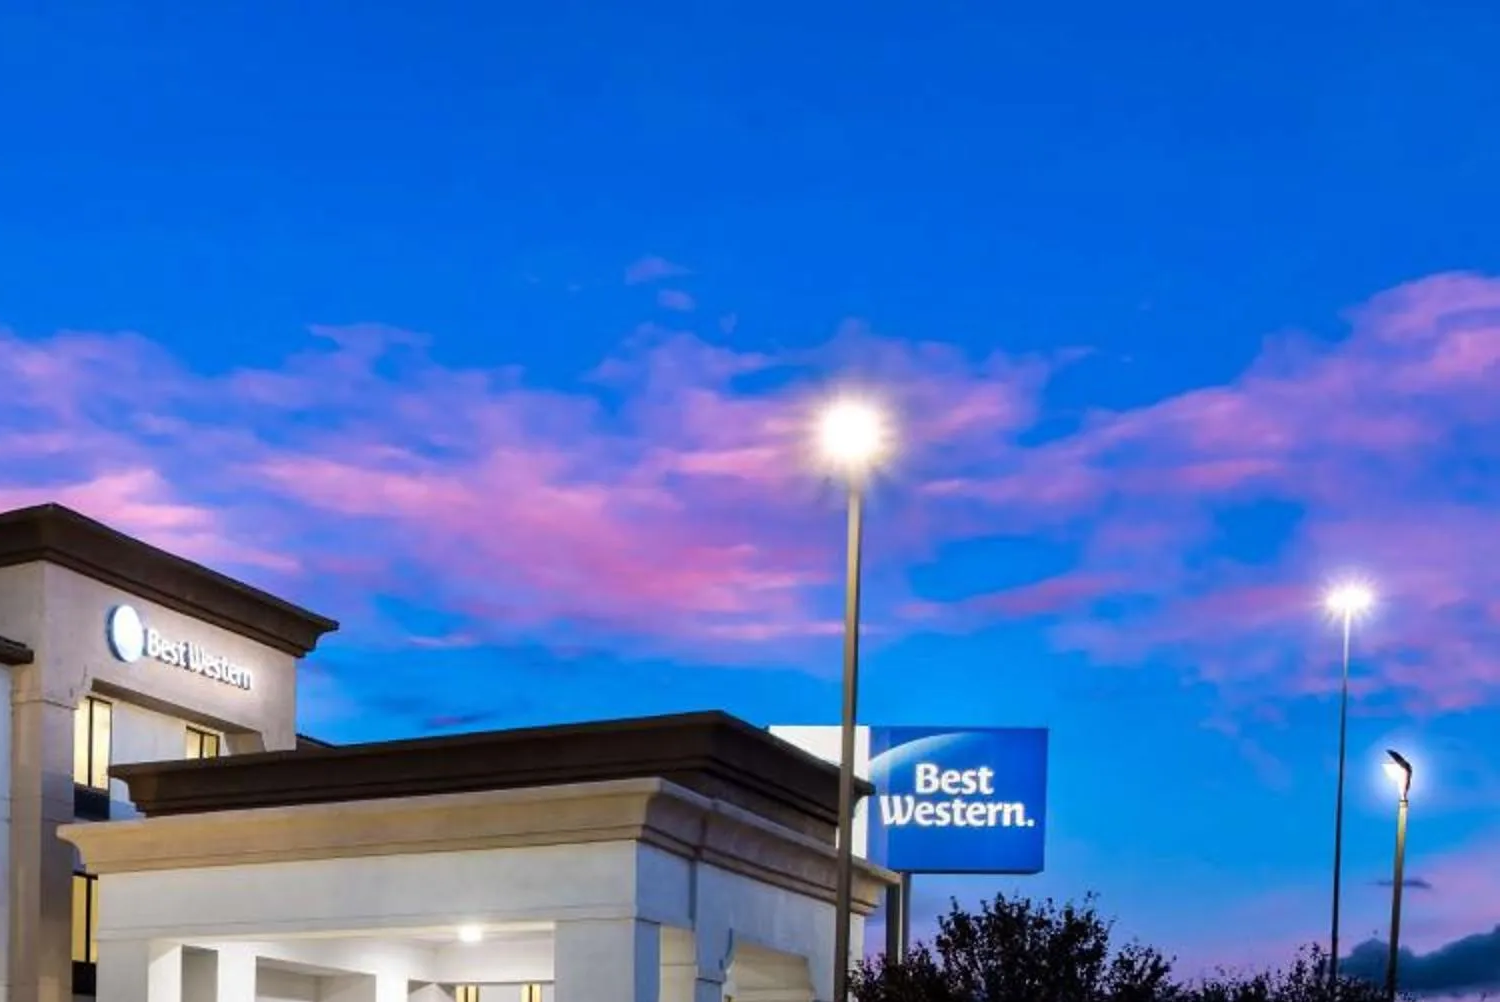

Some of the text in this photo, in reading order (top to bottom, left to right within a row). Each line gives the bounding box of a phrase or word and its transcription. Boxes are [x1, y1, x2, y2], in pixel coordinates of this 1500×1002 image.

[146, 628, 252, 690] Best Western
[916, 763, 994, 794] Best
